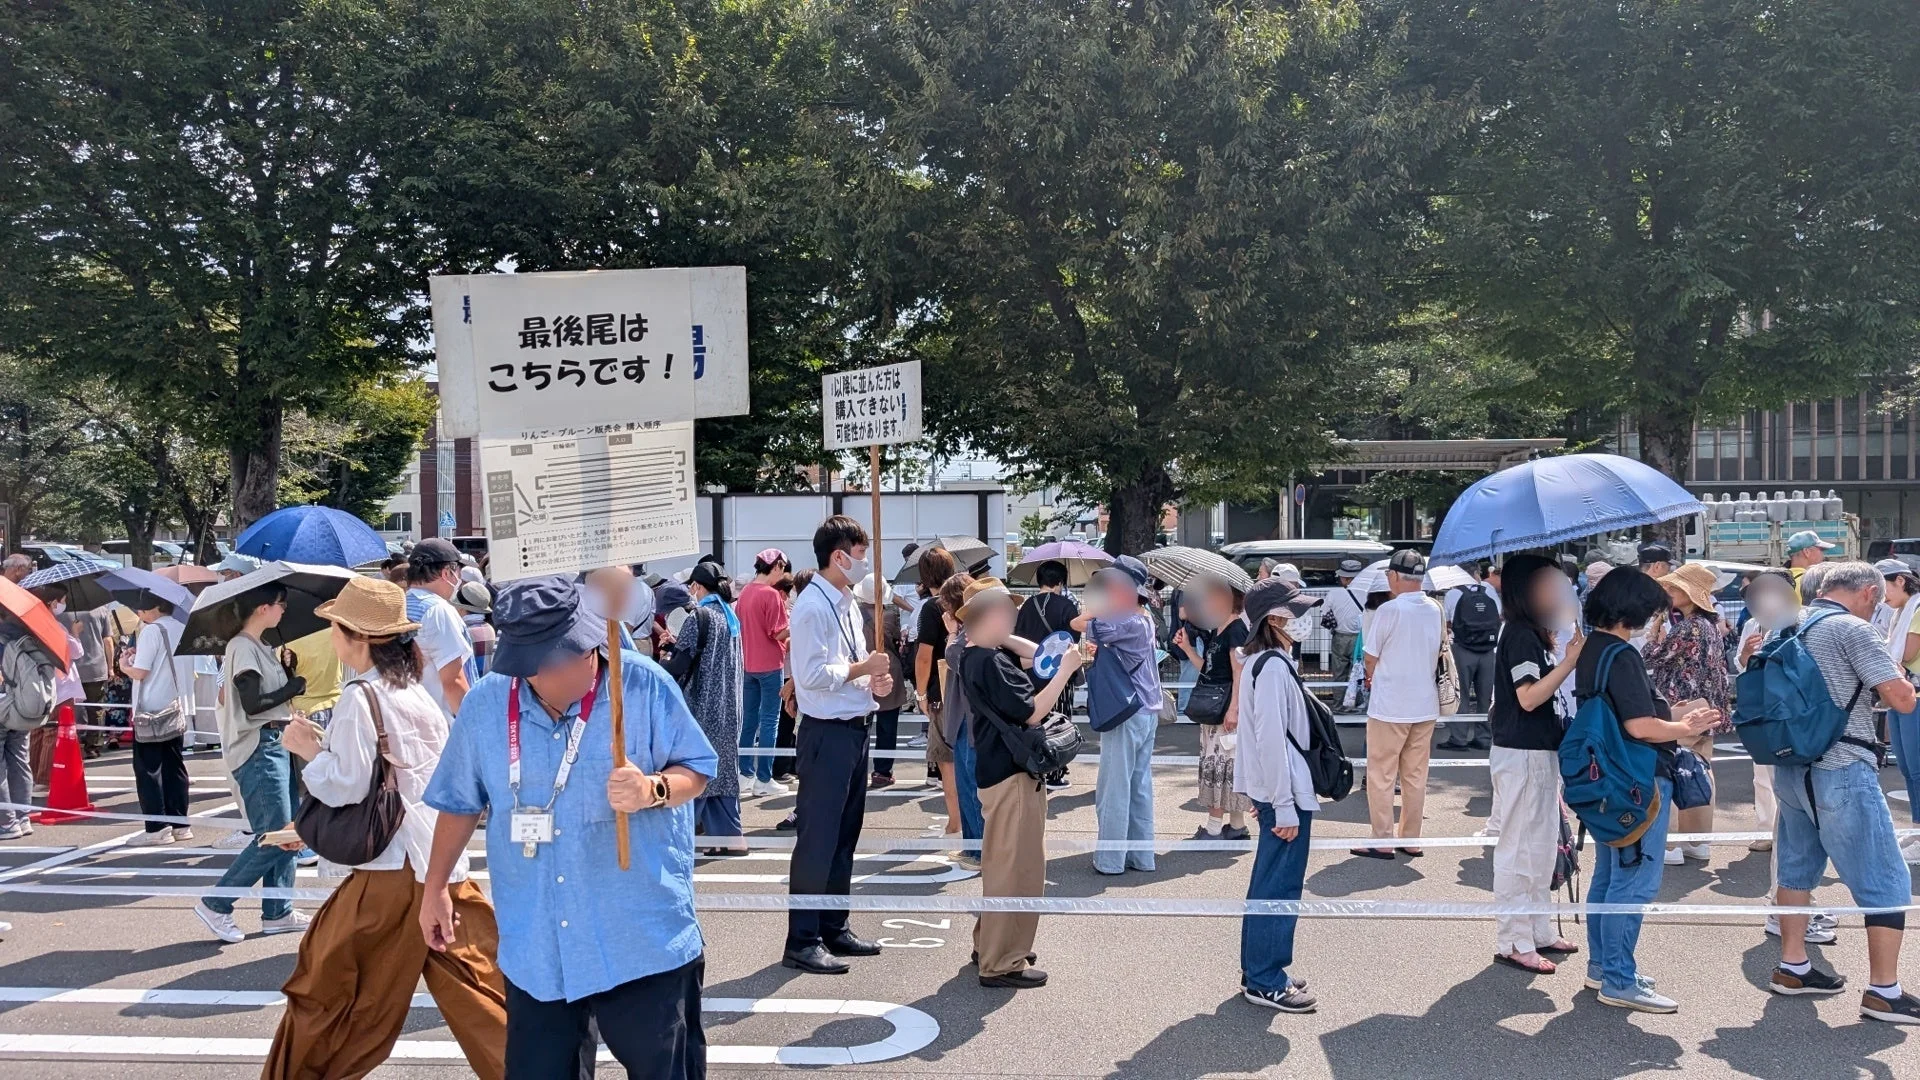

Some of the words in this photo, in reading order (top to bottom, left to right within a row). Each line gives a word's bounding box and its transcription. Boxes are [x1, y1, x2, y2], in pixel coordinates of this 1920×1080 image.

[518, 313, 649, 349] 最後尾は
[488, 353, 674, 393] こちらです！
[834, 368, 901, 398] 以降に並んだ方は
[835, 394, 901, 421] 購入できない
[521, 424, 622, 440] りんご・プルーン販売会
[626, 420, 662, 431] 購入順序
[836, 417, 902, 443] 可能性があります。
[510, 741, 518, 760] 2020
